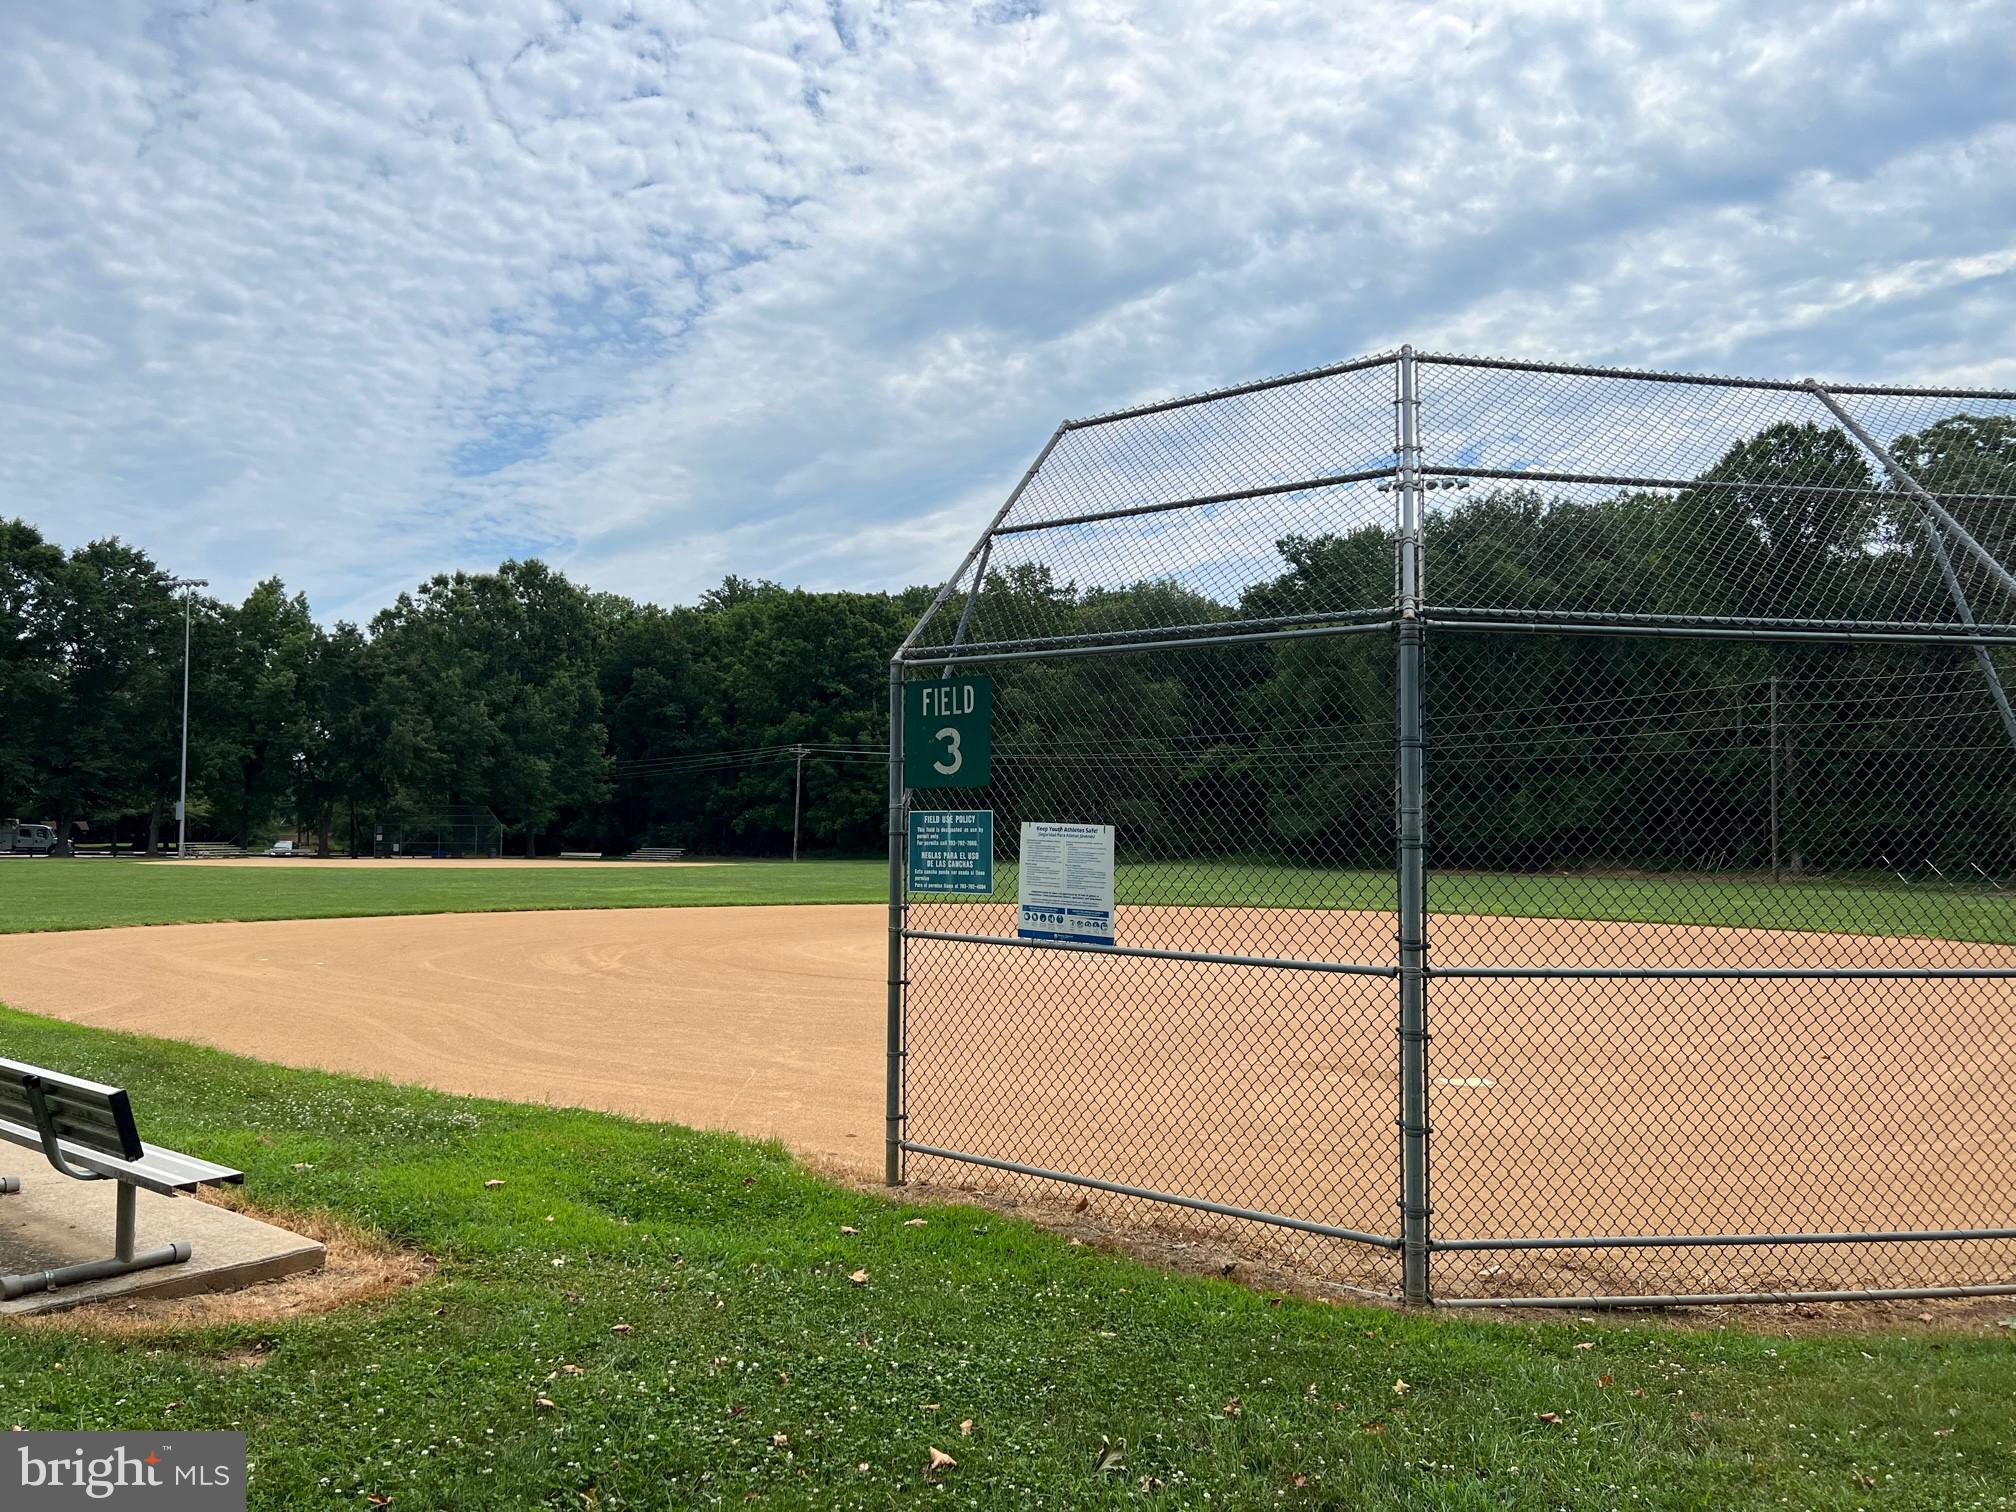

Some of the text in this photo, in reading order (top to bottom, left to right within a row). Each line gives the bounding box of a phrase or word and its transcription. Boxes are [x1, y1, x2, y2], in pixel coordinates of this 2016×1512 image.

[922, 685, 974, 716] FIELD
[933, 727, 962, 775] 3
[924, 815, 976, 824] FIELD USE POLICY
